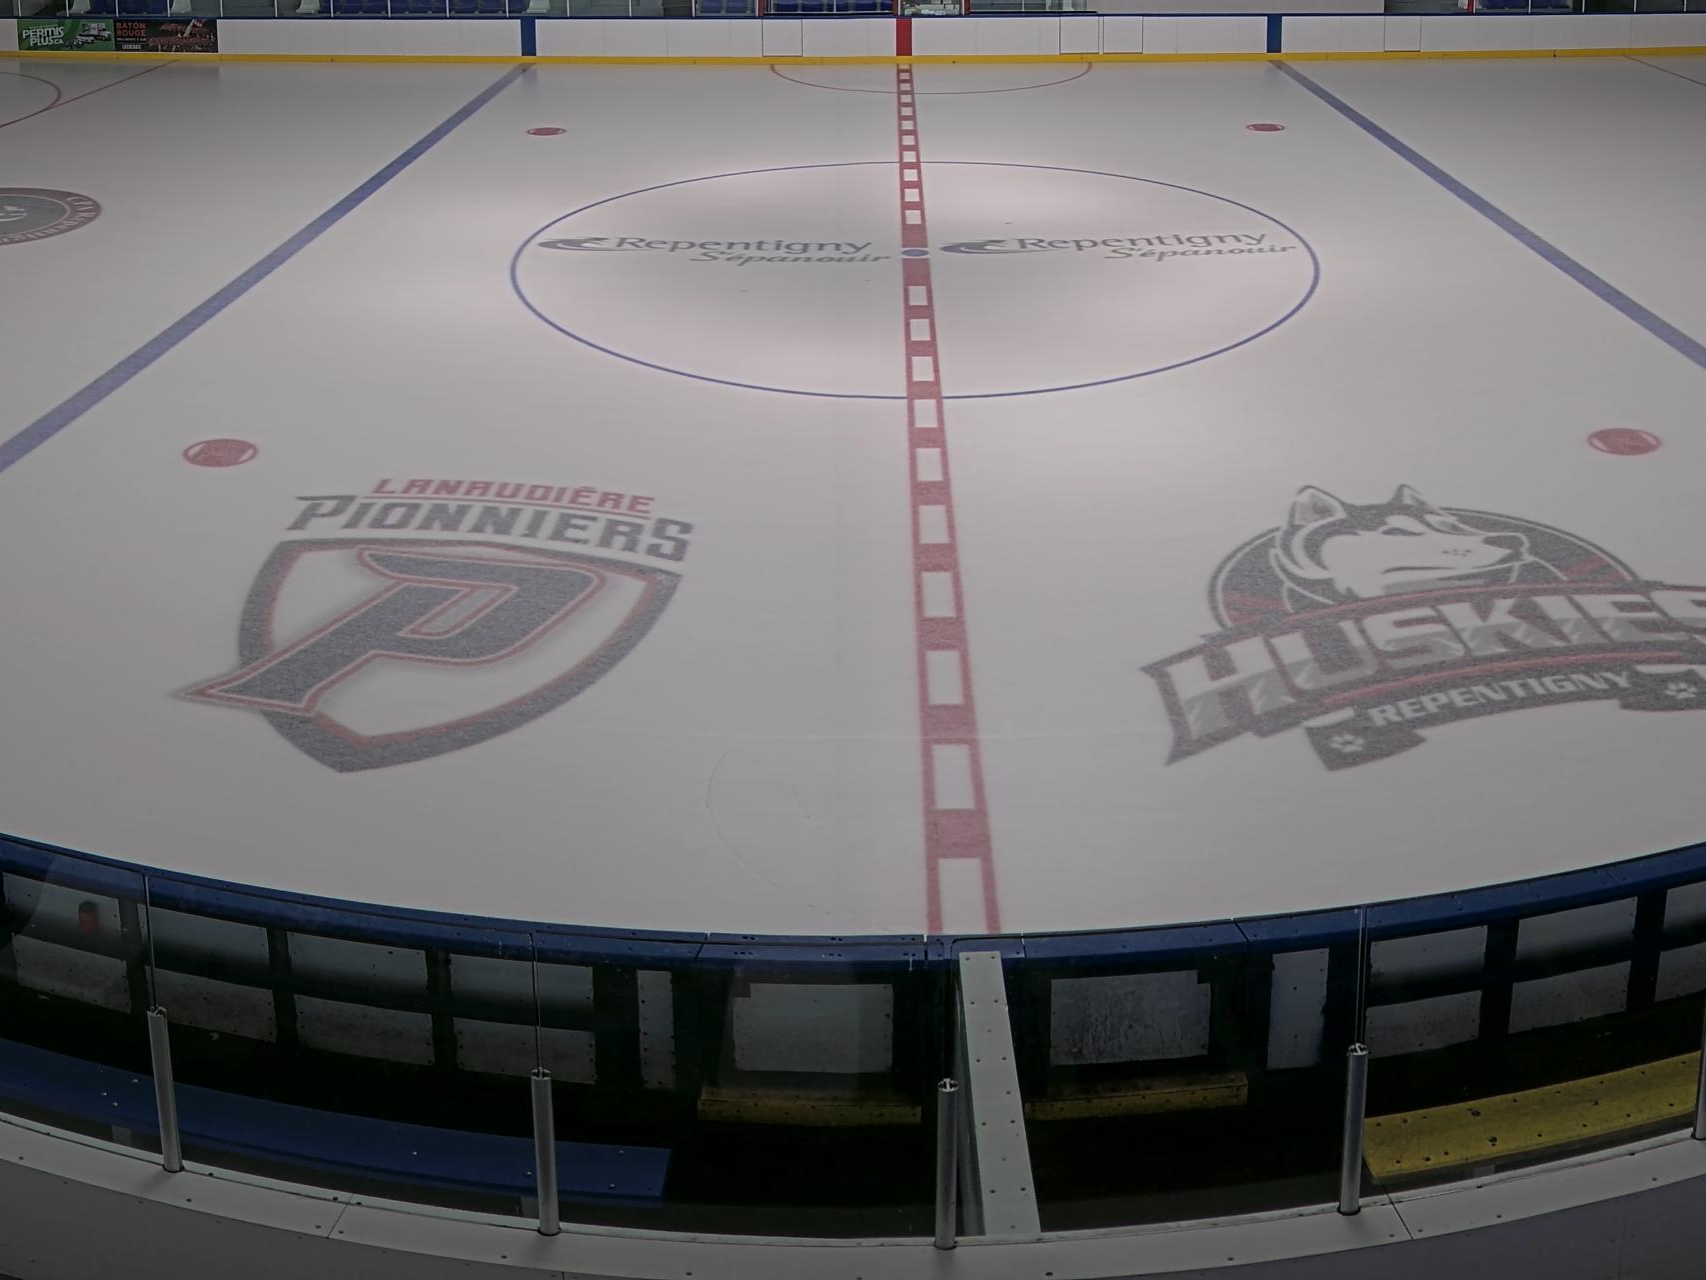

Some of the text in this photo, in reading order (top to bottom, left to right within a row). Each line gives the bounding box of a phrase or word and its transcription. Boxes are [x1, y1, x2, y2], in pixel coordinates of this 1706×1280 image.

[22, 26, 64, 39] PERMIS
[616, 236, 872, 255] Repentigny
[1015, 232, 1270, 251] Repentigny
[287, 494, 693, 564] PIONNIERS
[1369, 669, 1633, 727] REPENTIGNY
